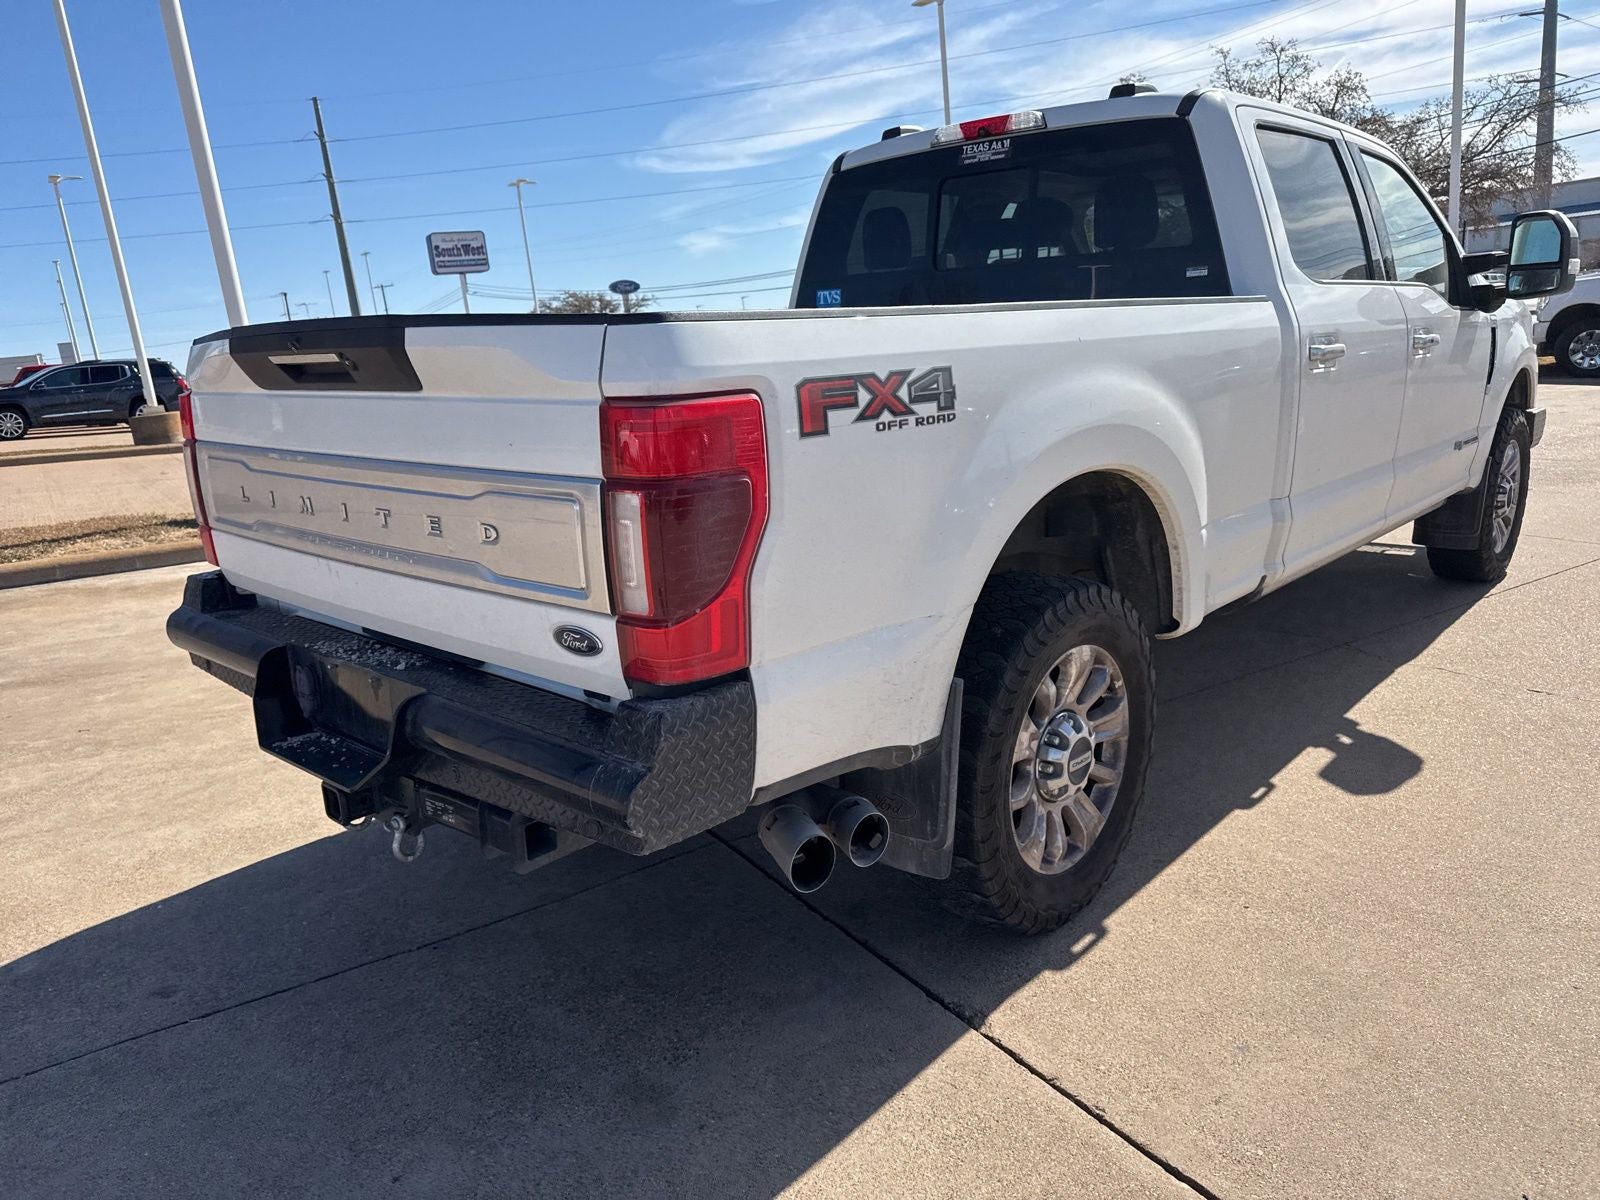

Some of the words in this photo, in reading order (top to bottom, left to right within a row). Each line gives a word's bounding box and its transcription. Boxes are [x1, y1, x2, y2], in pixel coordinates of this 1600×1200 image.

[962, 142, 990, 154] TEXAS
[816, 289, 841, 305] TVS
[795, 365, 957, 440] FX4
[875, 418, 909, 432] OFF
[915, 412, 957, 427] ROAD
[240, 485, 500, 546] LIMITED
[561, 631, 588, 651] Ford
